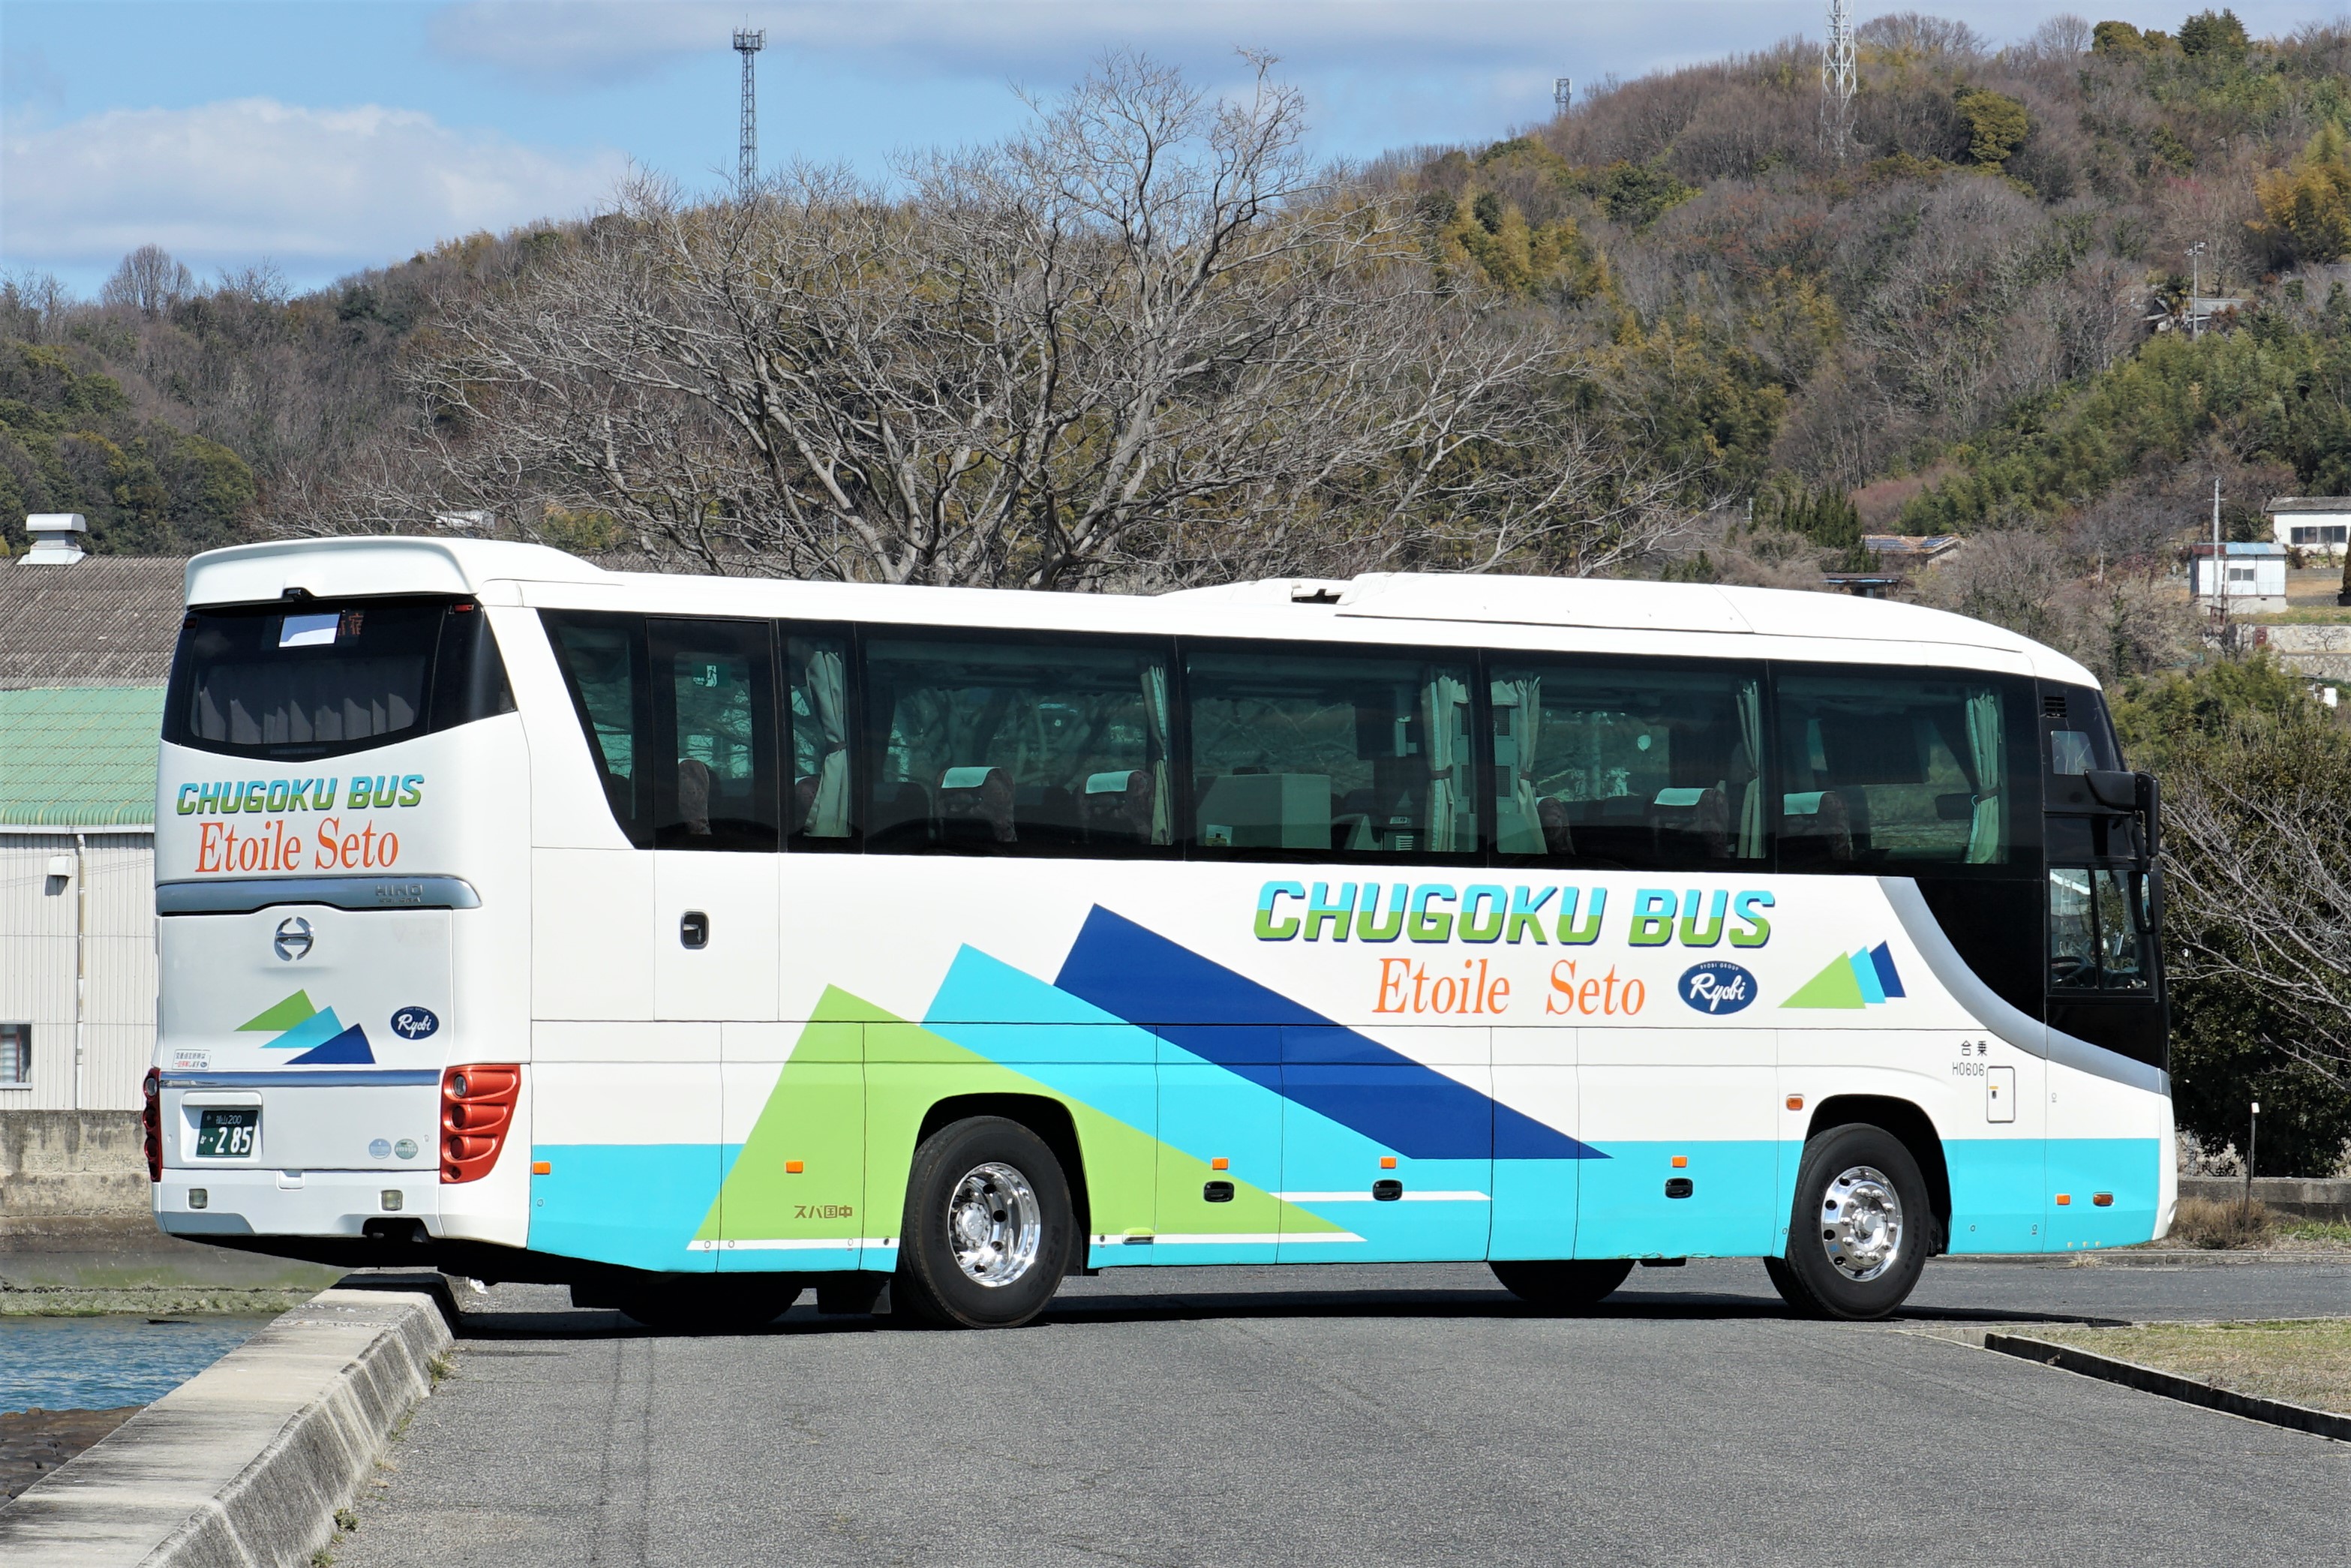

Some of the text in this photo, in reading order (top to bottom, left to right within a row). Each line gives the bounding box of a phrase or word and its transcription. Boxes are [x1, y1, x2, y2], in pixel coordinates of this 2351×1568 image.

[176, 773, 425, 816] CHUGOKU BUS
[194, 816, 399, 873] Etoile Seto
[375, 884, 423, 897] HINO
[1253, 880, 1776, 949] CHUGOKU BUS
[1371, 957, 1646, 1016] Etoile Seto
[1689, 972, 1746, 1012] Ryobi
[397, 1013, 432, 1038] Ryobi
[1952, 1062, 1985, 1077] H0606
